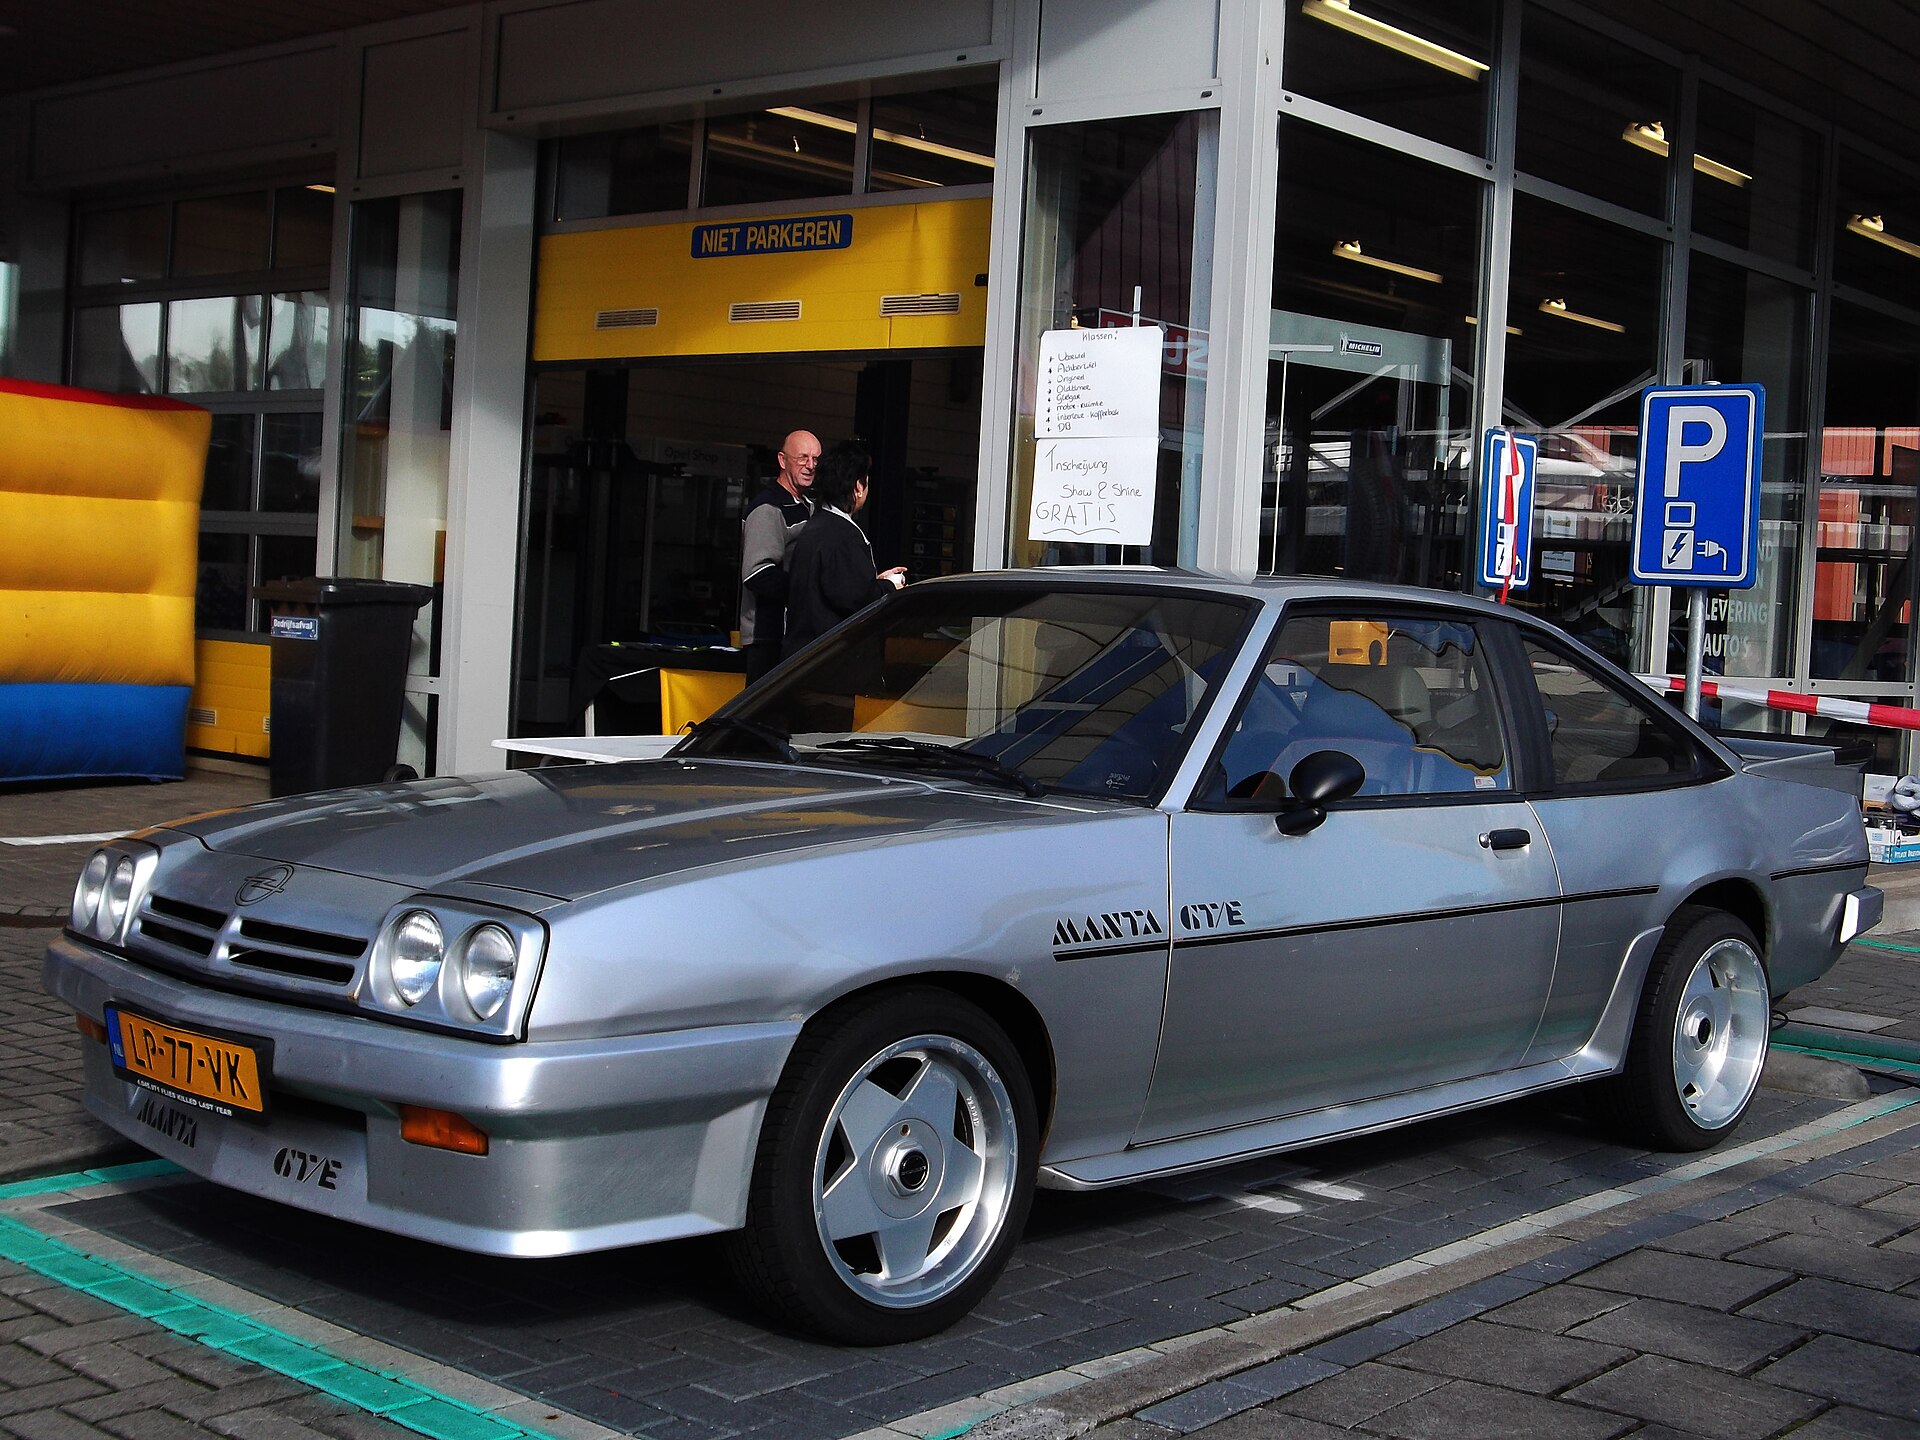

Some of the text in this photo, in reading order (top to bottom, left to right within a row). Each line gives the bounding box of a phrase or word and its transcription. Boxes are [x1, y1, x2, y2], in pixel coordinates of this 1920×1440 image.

[701, 219, 842, 254] NIET PARKEREN
[1348, 342, 1381, 353] MICHELIN
[665, 446, 719, 464] Opel Shop
[1664, 405, 1728, 498] P
[1060, 484, 1092, 499] Show
[1112, 483, 1142, 497] Shine
[273, 618, 313, 630] Bedrijfsafval
[1685, 596, 1768, 624] LEVERING
[1052, 900, 1246, 946] MANTA GT/E
[113, 1042, 124, 1058] NL
[128, 1022, 250, 1100] LP-77-VK
[160, 1087, 177, 1099] FLIES
[176, 1094, 198, 1106] KILLED
[198, 1100, 214, 1111] LAST
[214, 1105, 233, 1117] YEAR
[136, 1098, 343, 1191] MANTA GT/E
